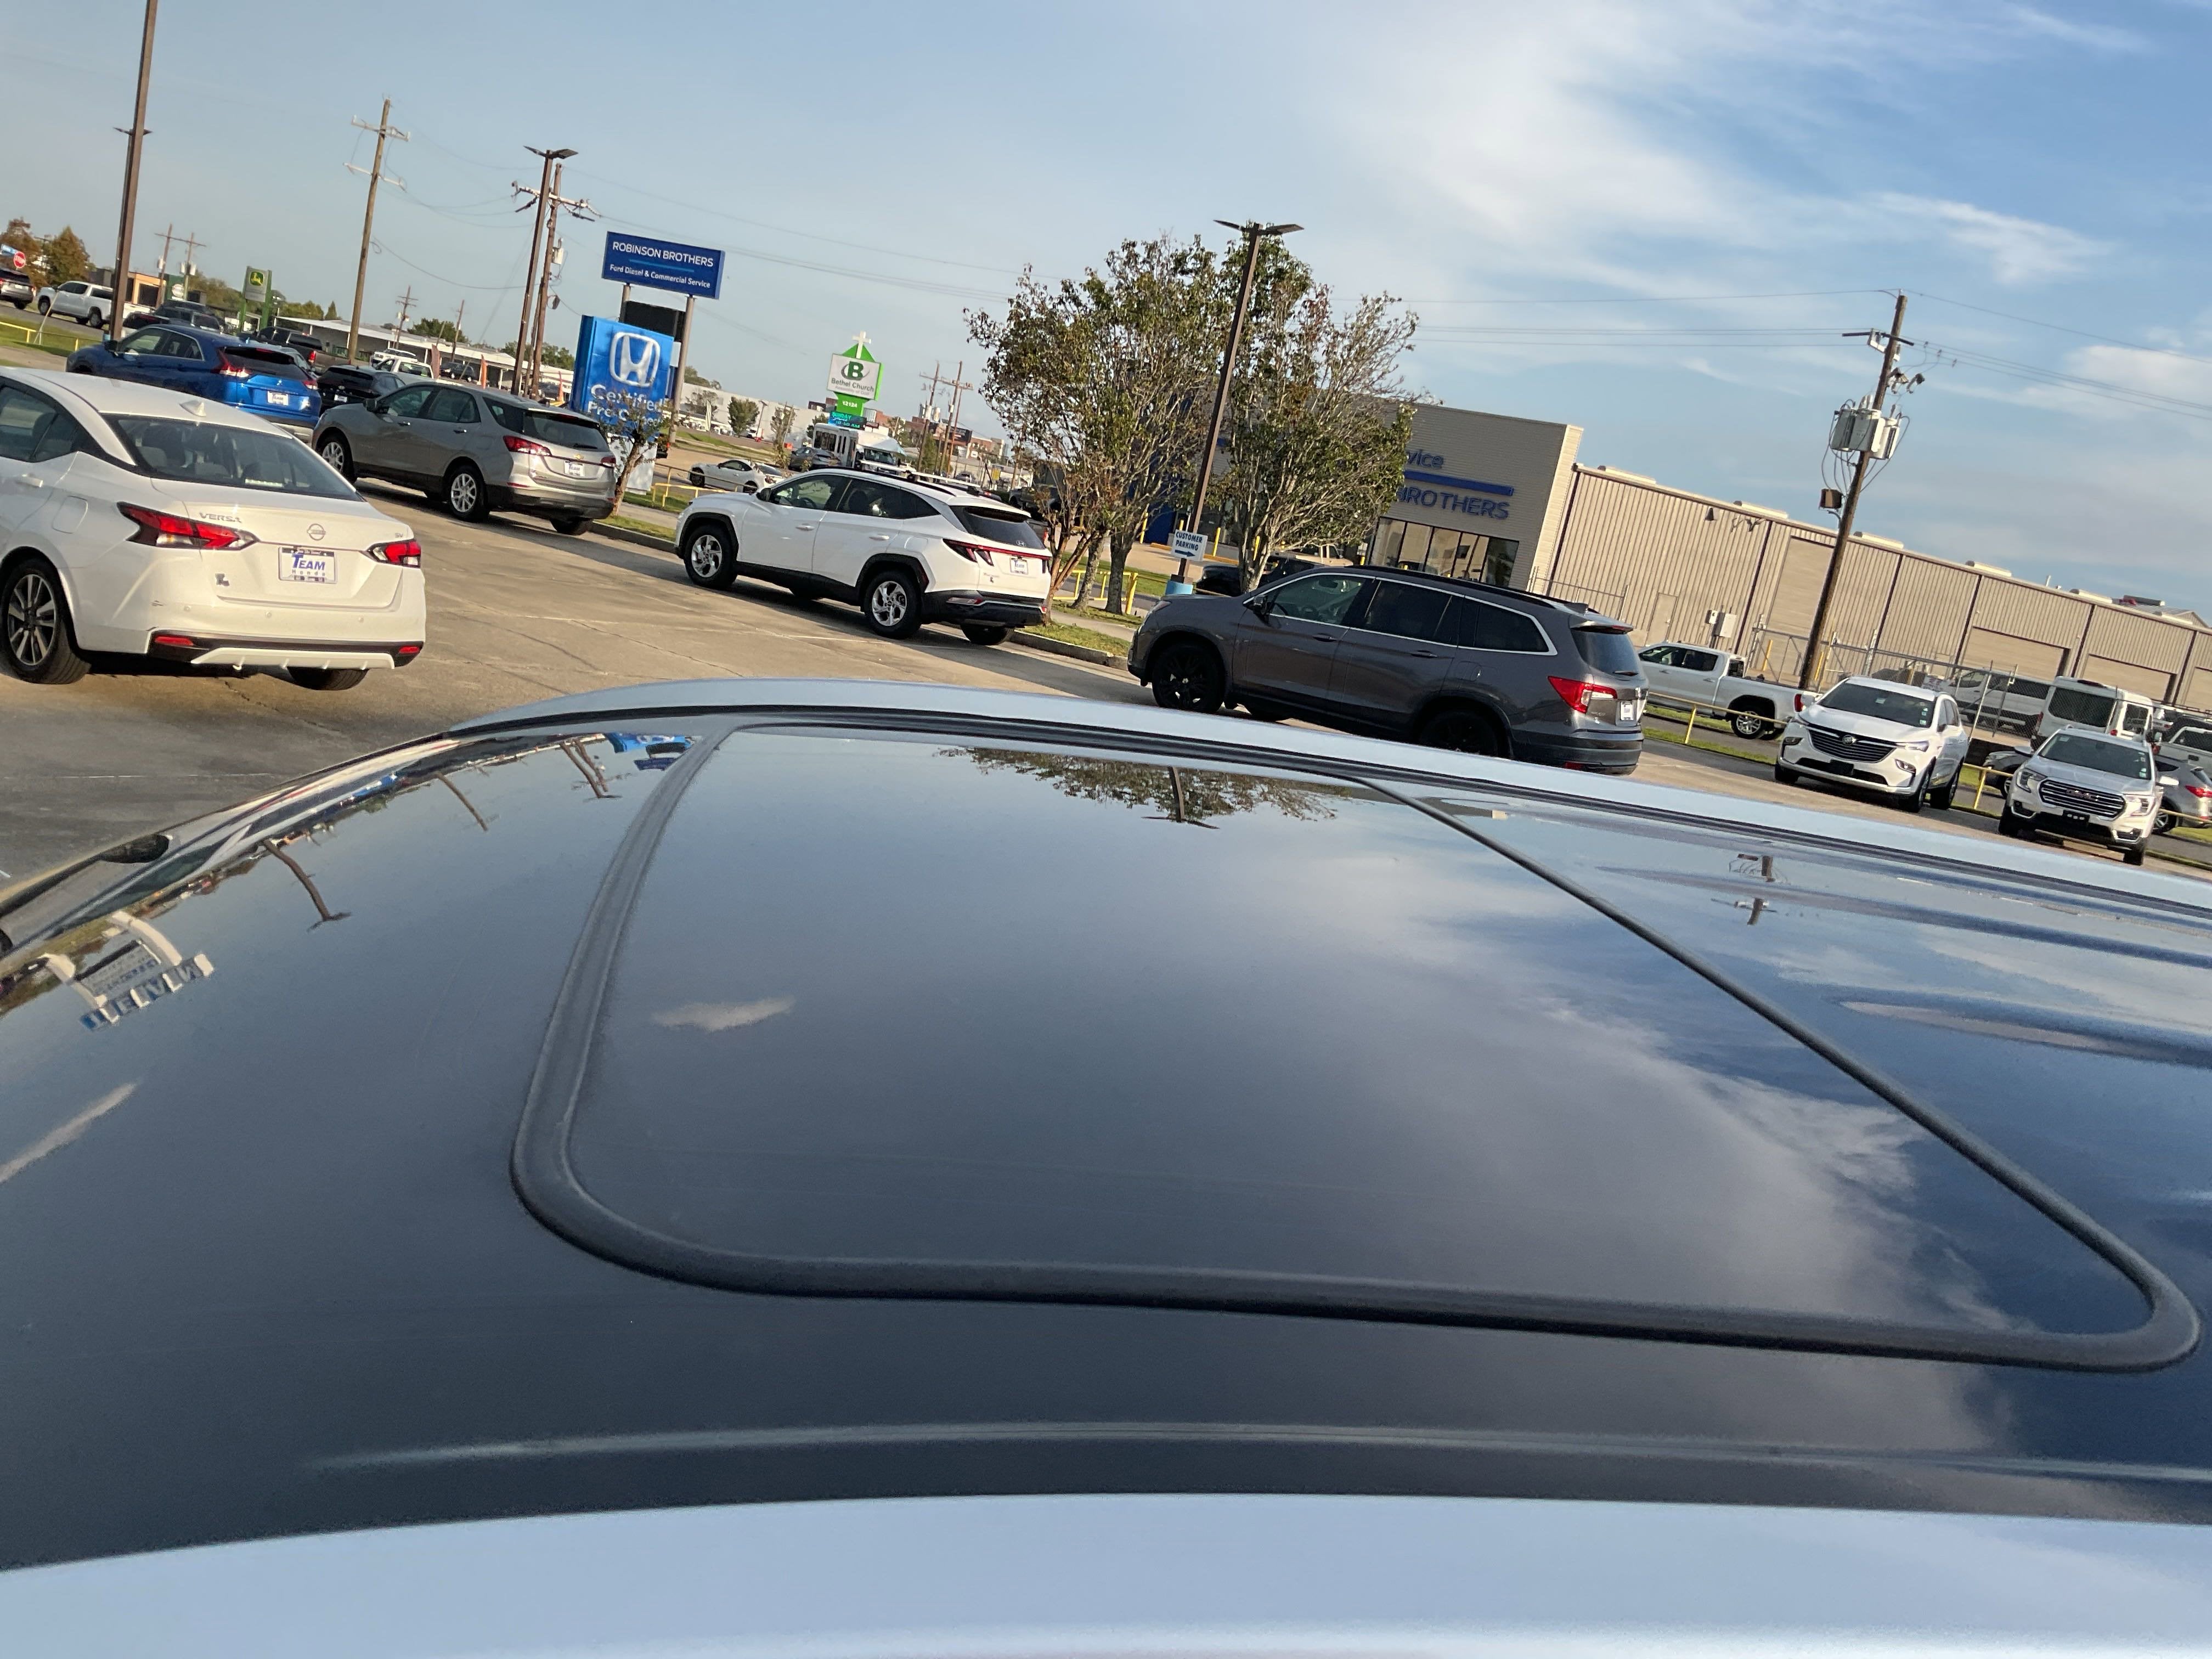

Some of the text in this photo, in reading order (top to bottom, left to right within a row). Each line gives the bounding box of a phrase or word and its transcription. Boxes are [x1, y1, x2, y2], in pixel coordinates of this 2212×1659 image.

[612, 241, 714, 267] ROBINSON BROTHERS
[610, 263, 624, 273] Ford
[624, 266, 644, 276] Diesel
[650, 271, 687, 284] Commercial
[687, 278, 710, 289] Service
[831, 377, 874, 392] Bethel Church
[1406, 449, 1444, 470] vice
[1396, 486, 1510, 520] BROTHERS
[1176, 531, 1203, 543] CUSTOMER
[1176, 540, 1199, 551] PARKING
[291, 552, 325, 571] TEAM
